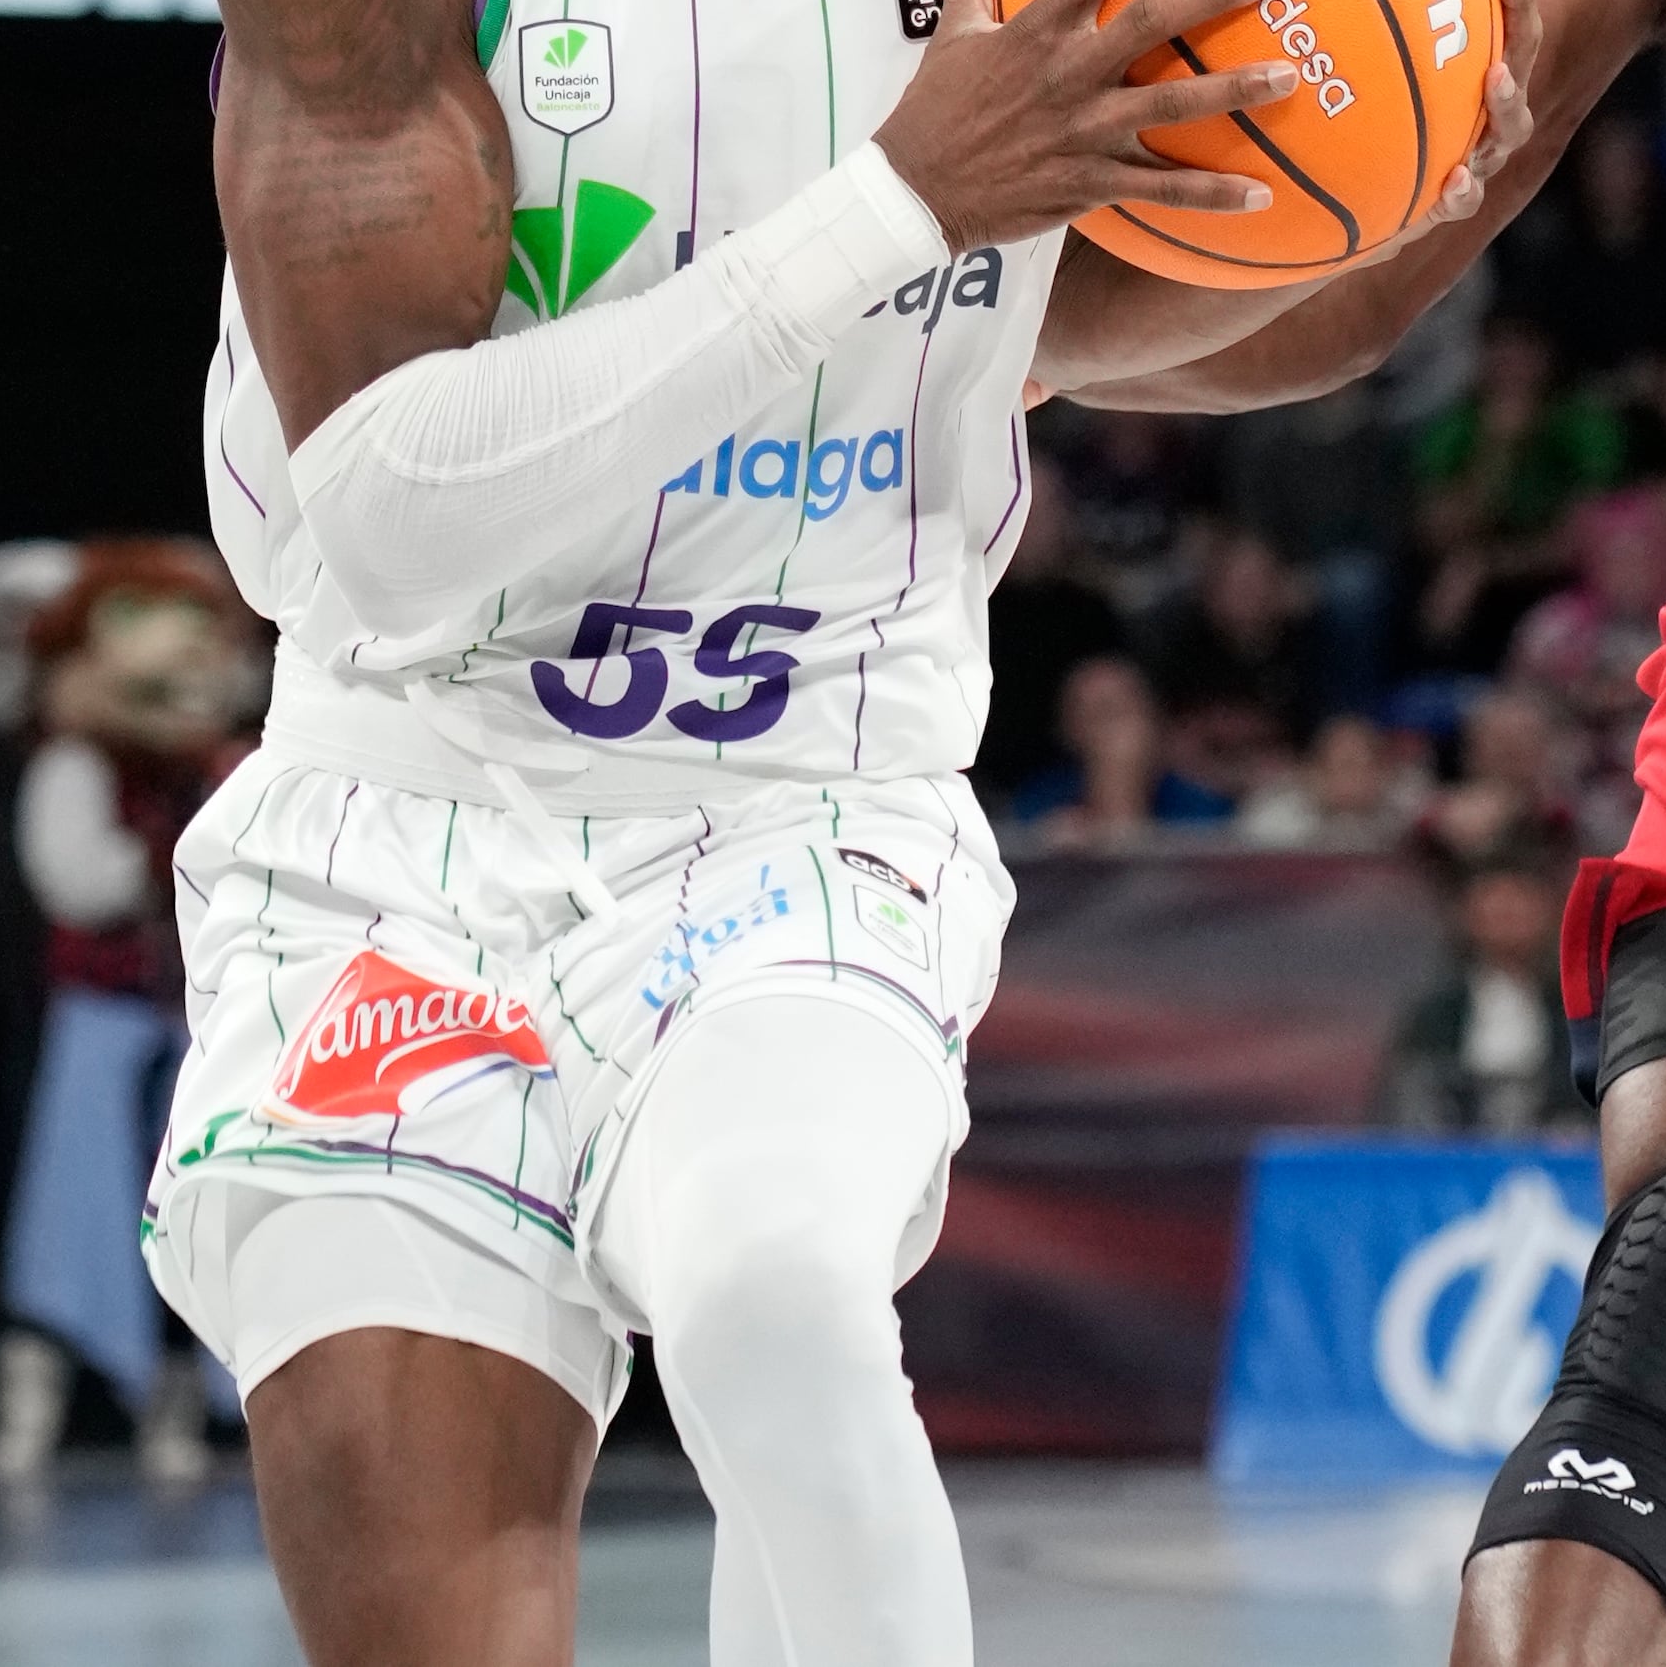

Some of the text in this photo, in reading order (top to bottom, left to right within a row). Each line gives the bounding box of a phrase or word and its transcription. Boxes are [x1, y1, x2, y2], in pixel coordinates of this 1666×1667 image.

[535, 74, 599, 87] Fundación
[545, 88, 591, 103] Unicaja
[530, 601, 822, 742] 55
[846, 854, 912, 893] acb
